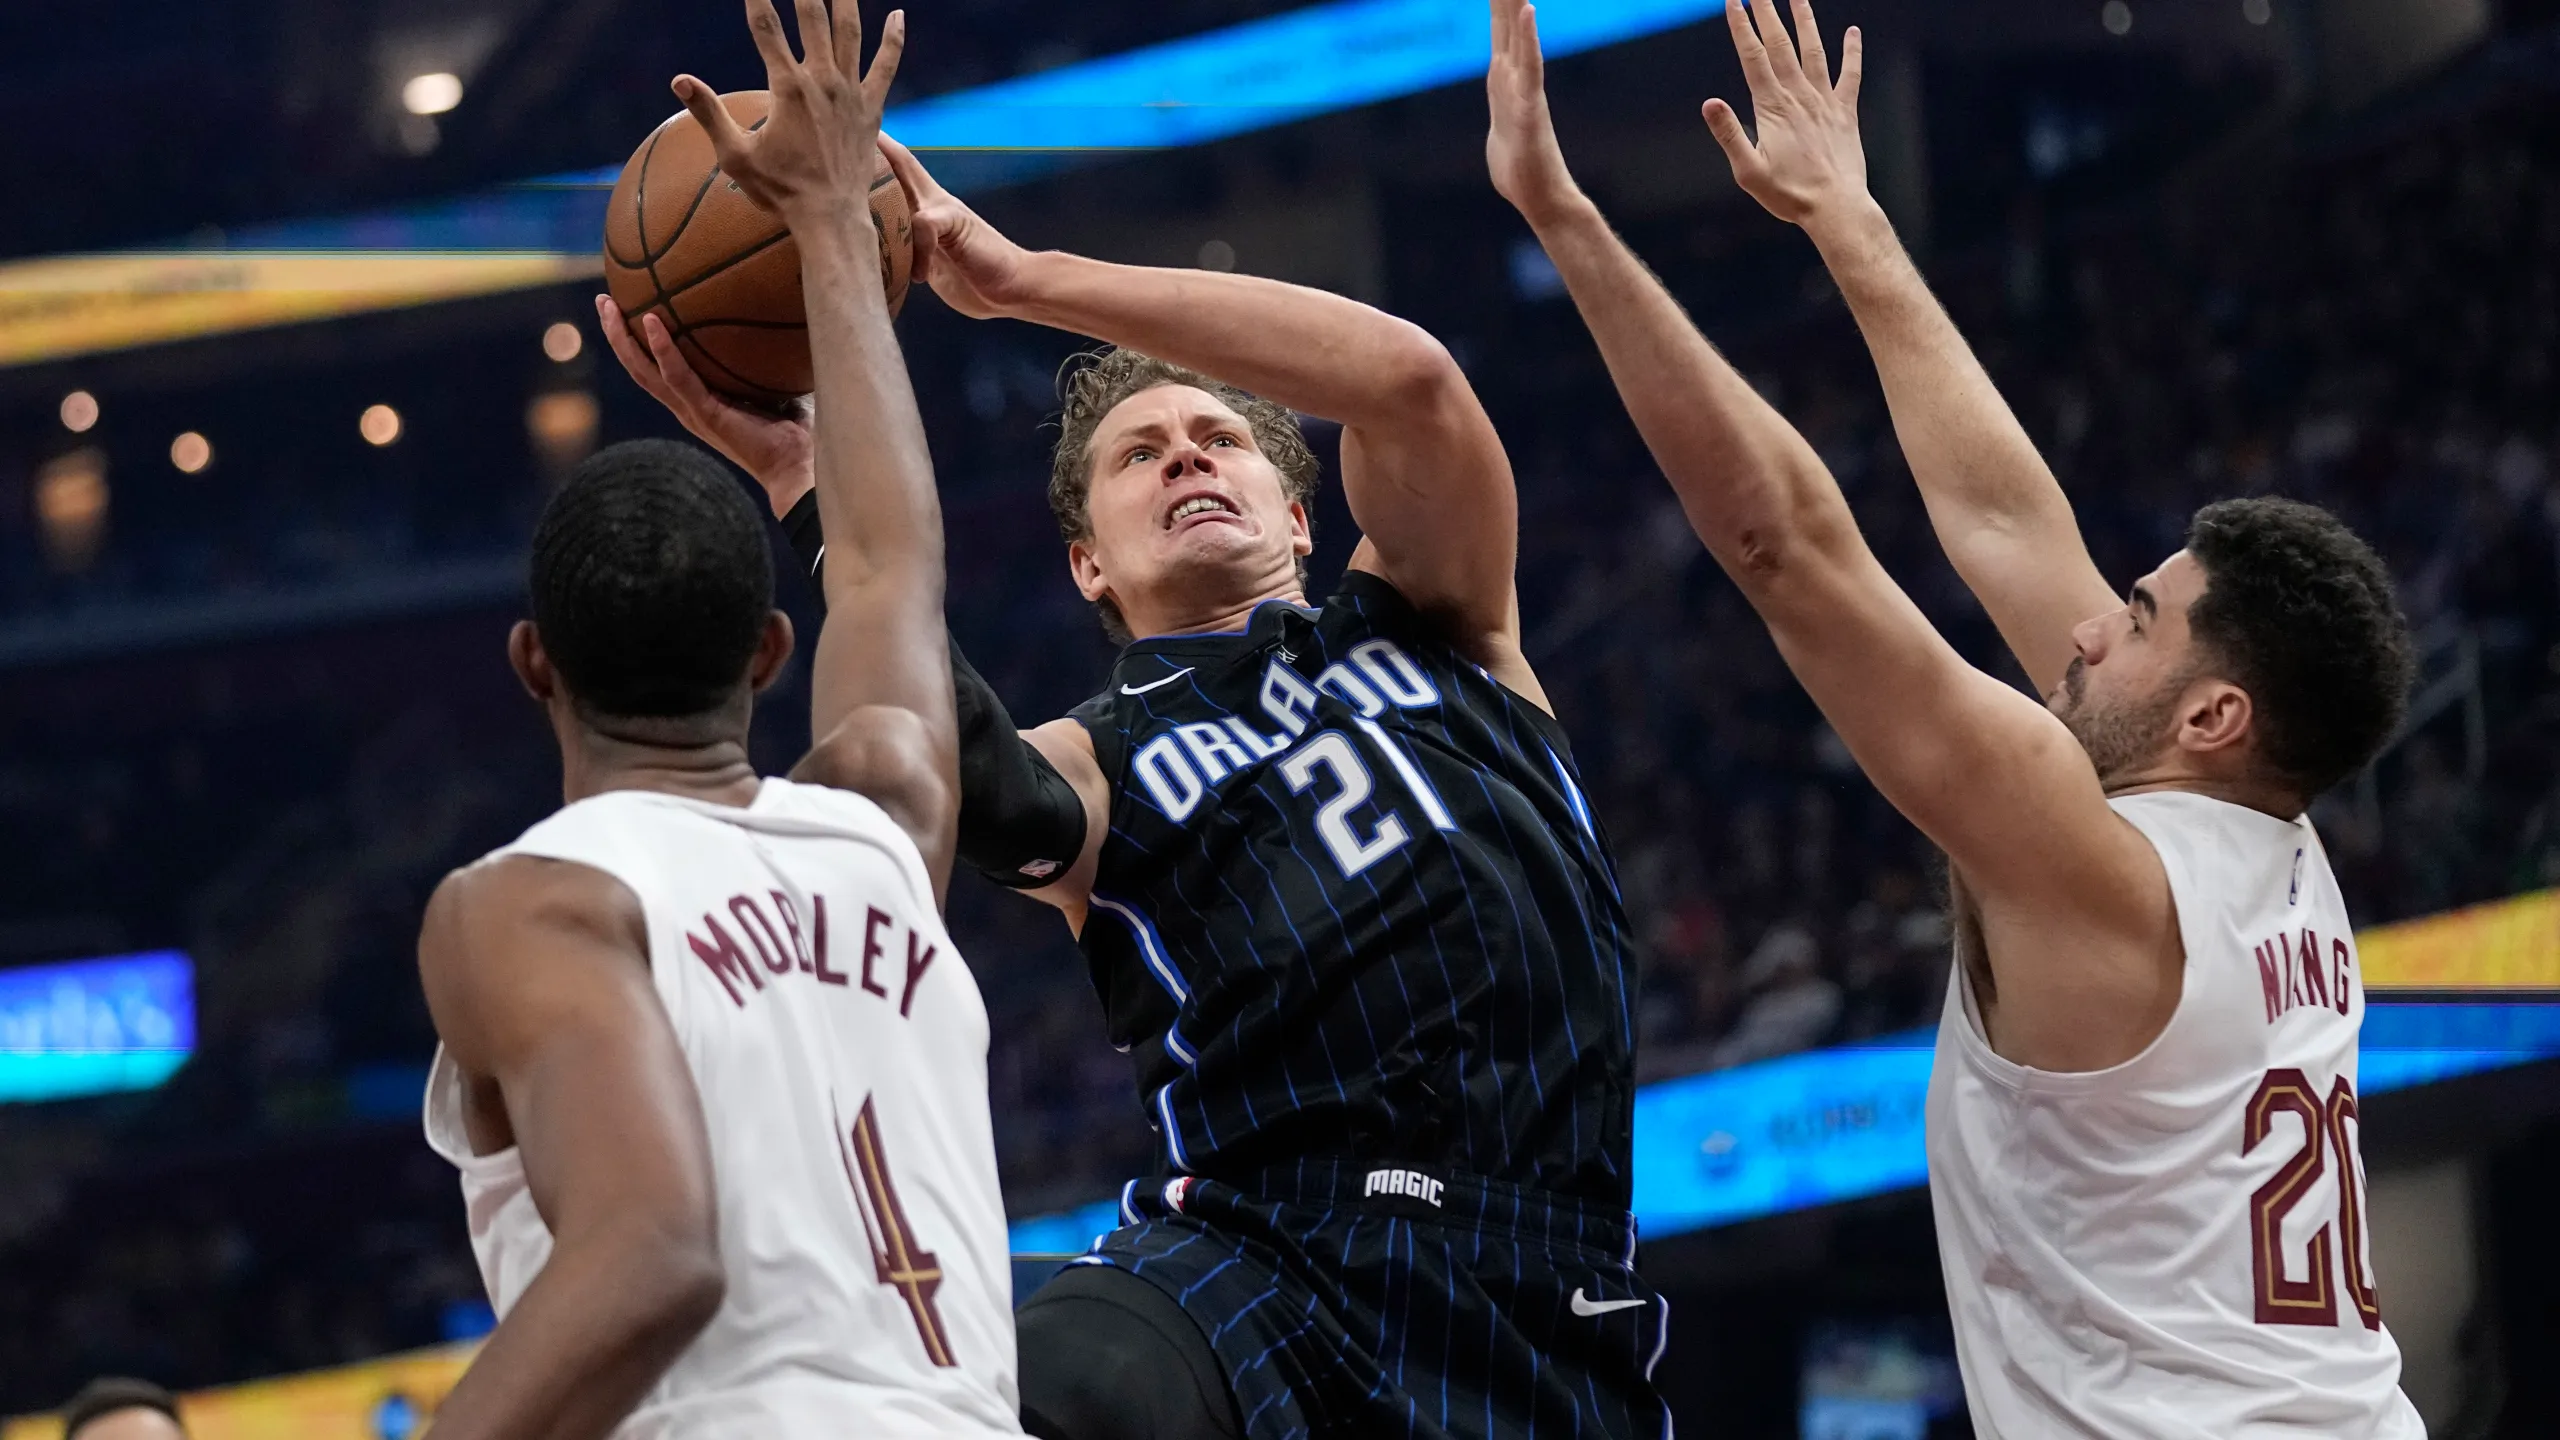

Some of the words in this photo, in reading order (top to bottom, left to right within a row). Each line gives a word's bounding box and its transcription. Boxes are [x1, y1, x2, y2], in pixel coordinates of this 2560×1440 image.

[1132, 638, 1442, 825] ORLADO
[1275, 715, 1459, 880] 21
[831, 1088, 960, 1368] 4
[1364, 1169, 1444, 1208] MAGIC
